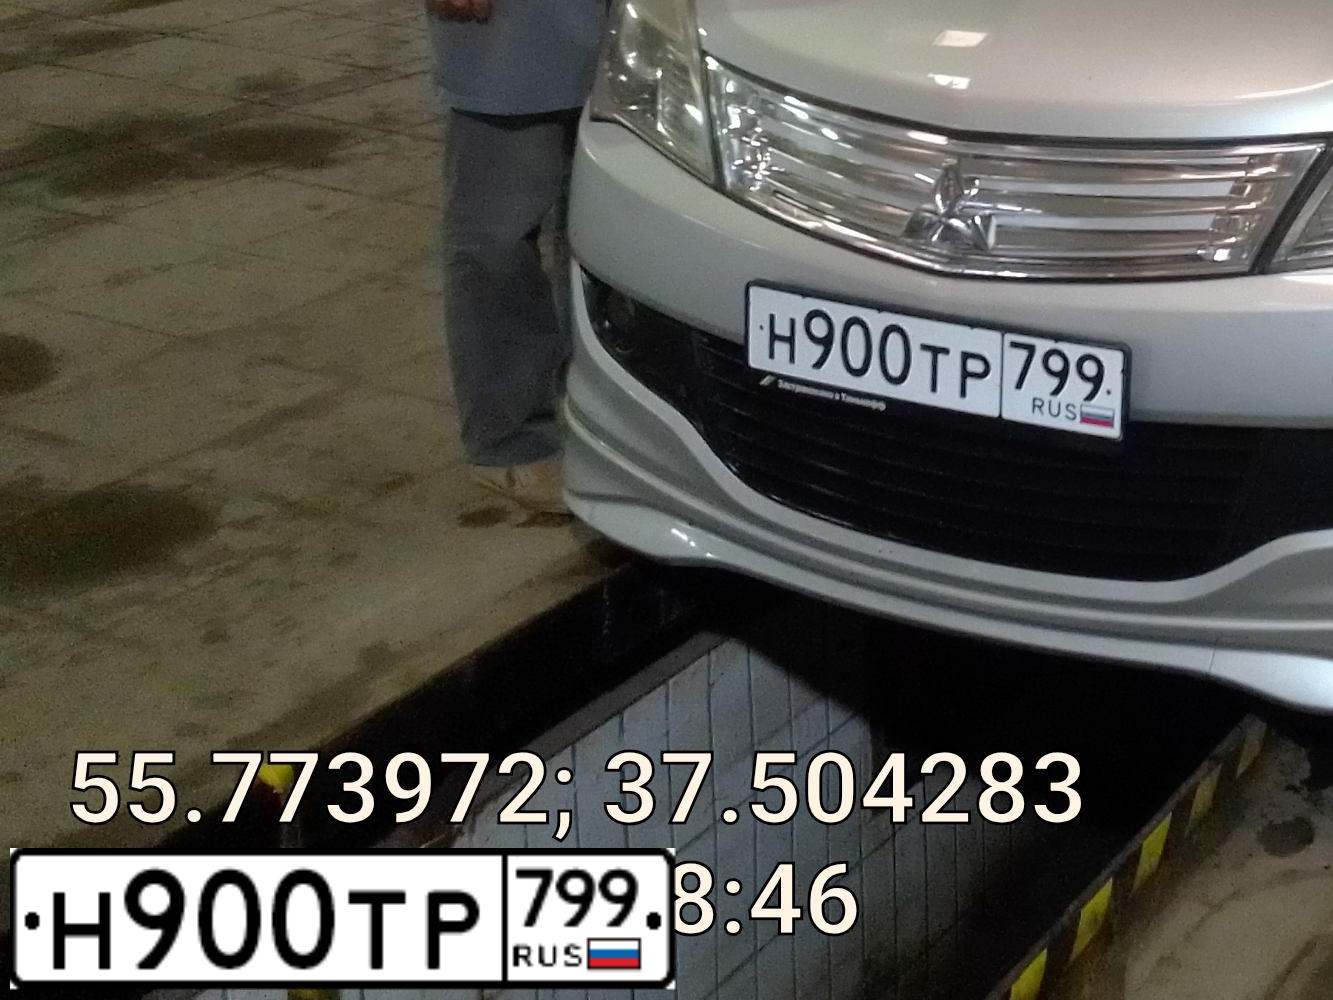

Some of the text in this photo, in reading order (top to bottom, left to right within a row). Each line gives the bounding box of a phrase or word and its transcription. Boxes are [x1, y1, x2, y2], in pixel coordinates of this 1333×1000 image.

[767, 309, 1105, 402] Н900ТР 799
[1031, 397, 1078, 421] RUS
